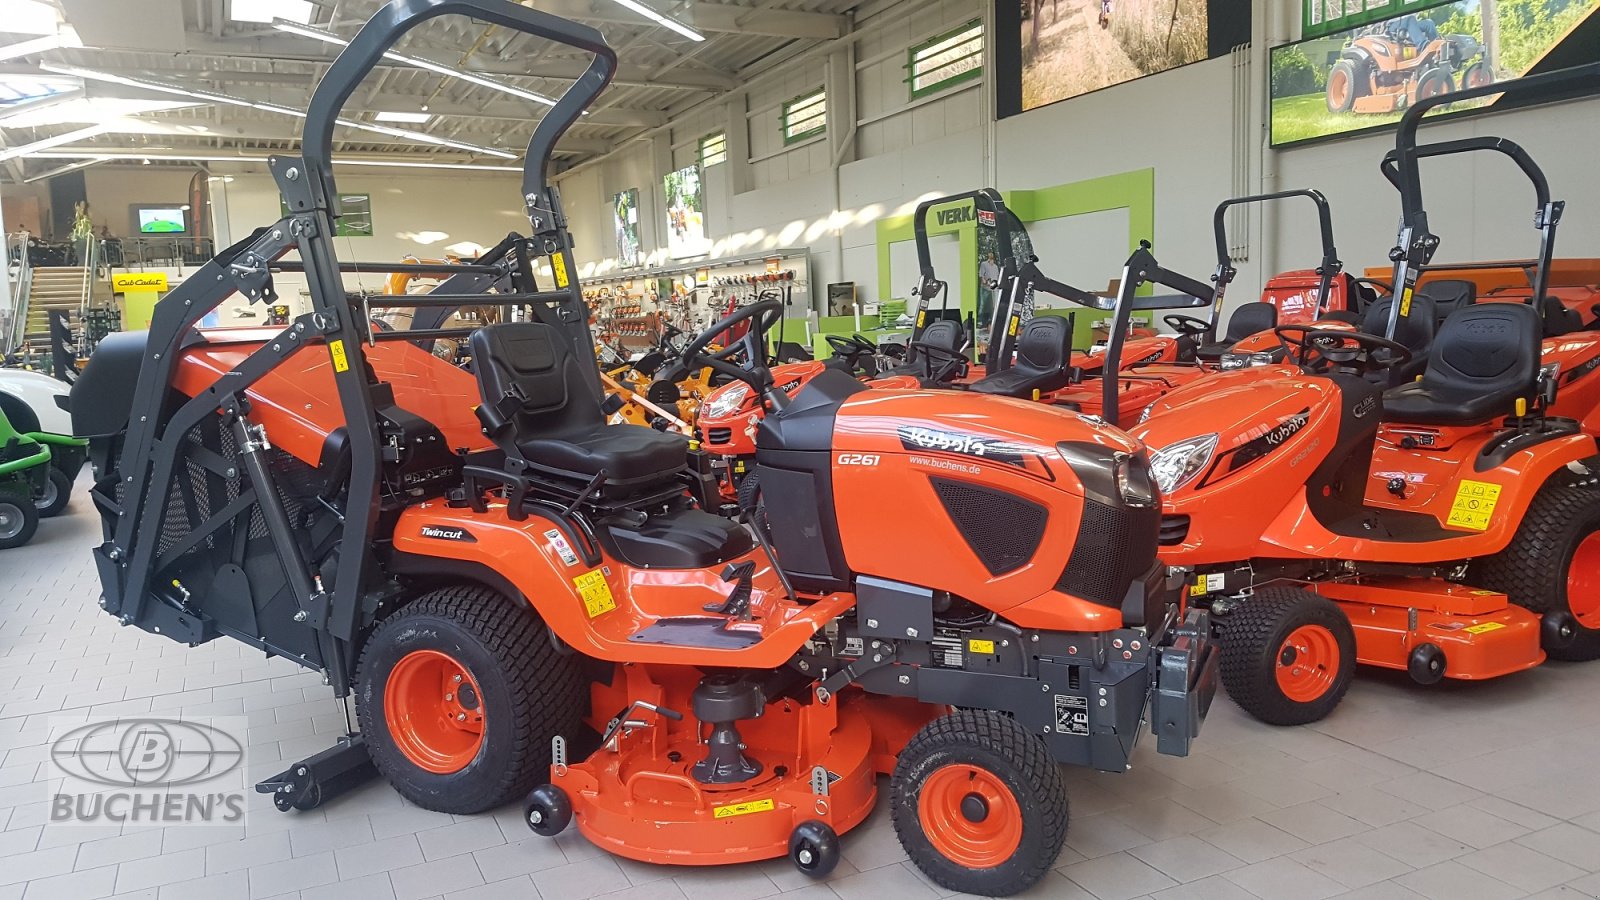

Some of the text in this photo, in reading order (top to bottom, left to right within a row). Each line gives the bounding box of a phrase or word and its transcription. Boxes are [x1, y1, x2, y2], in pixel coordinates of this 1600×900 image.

[909, 427, 985, 456] Kubota
[1265, 416, 1307, 446] Kubota
[837, 453, 881, 466] G261
[909, 455, 981, 475] www.buchens.de
